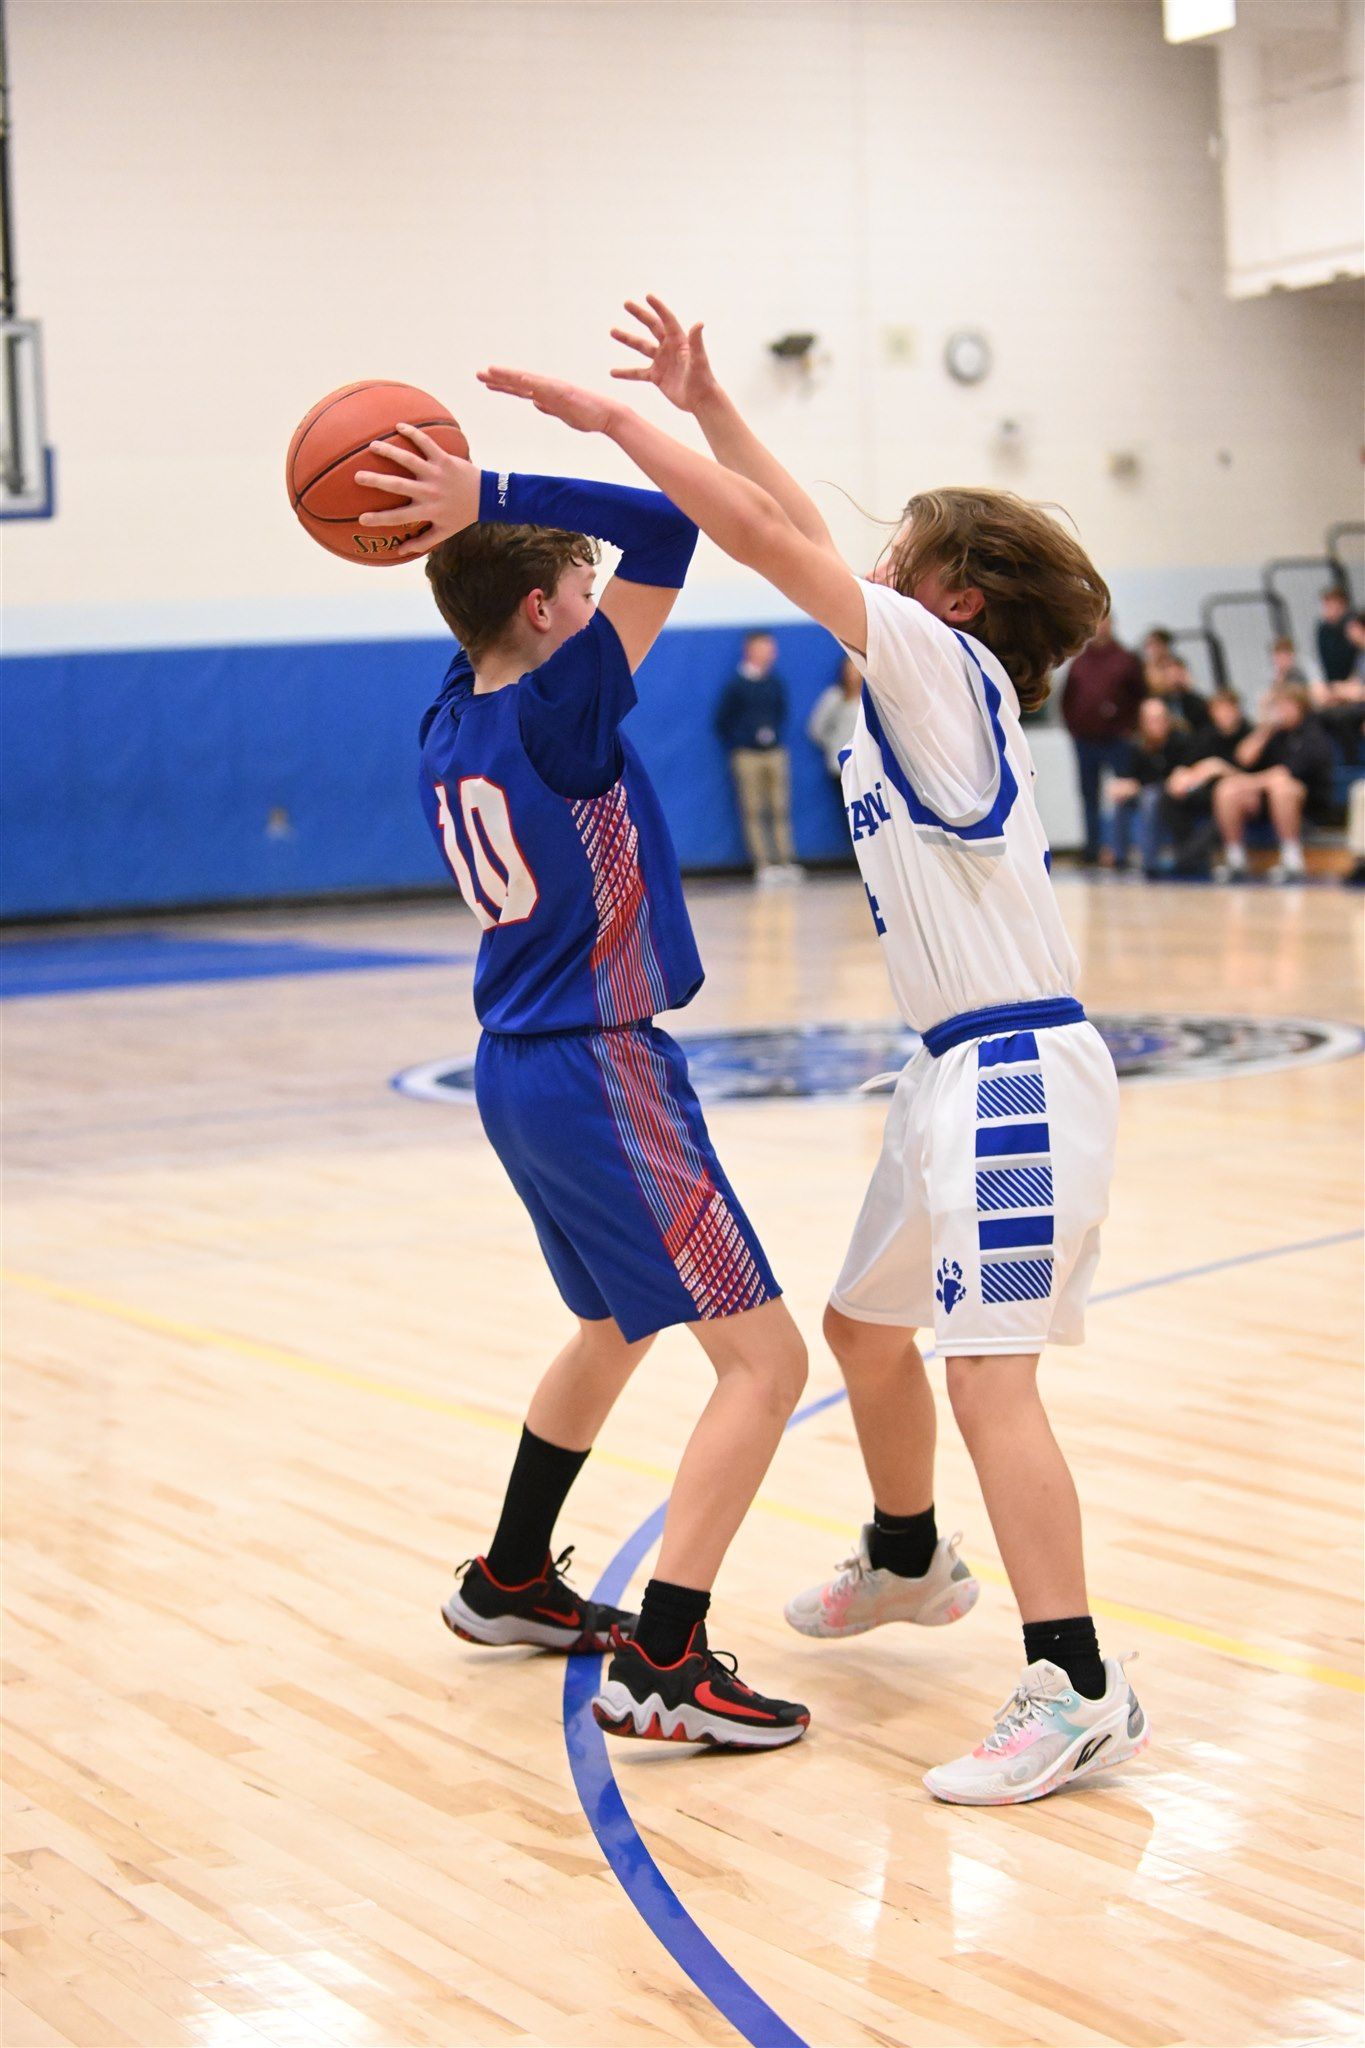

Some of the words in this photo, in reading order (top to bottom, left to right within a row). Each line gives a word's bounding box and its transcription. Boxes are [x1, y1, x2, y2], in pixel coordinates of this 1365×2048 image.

[352, 533, 410, 553] SPA
[844, 782, 891, 841] AN
[434, 775, 539, 931] 10
